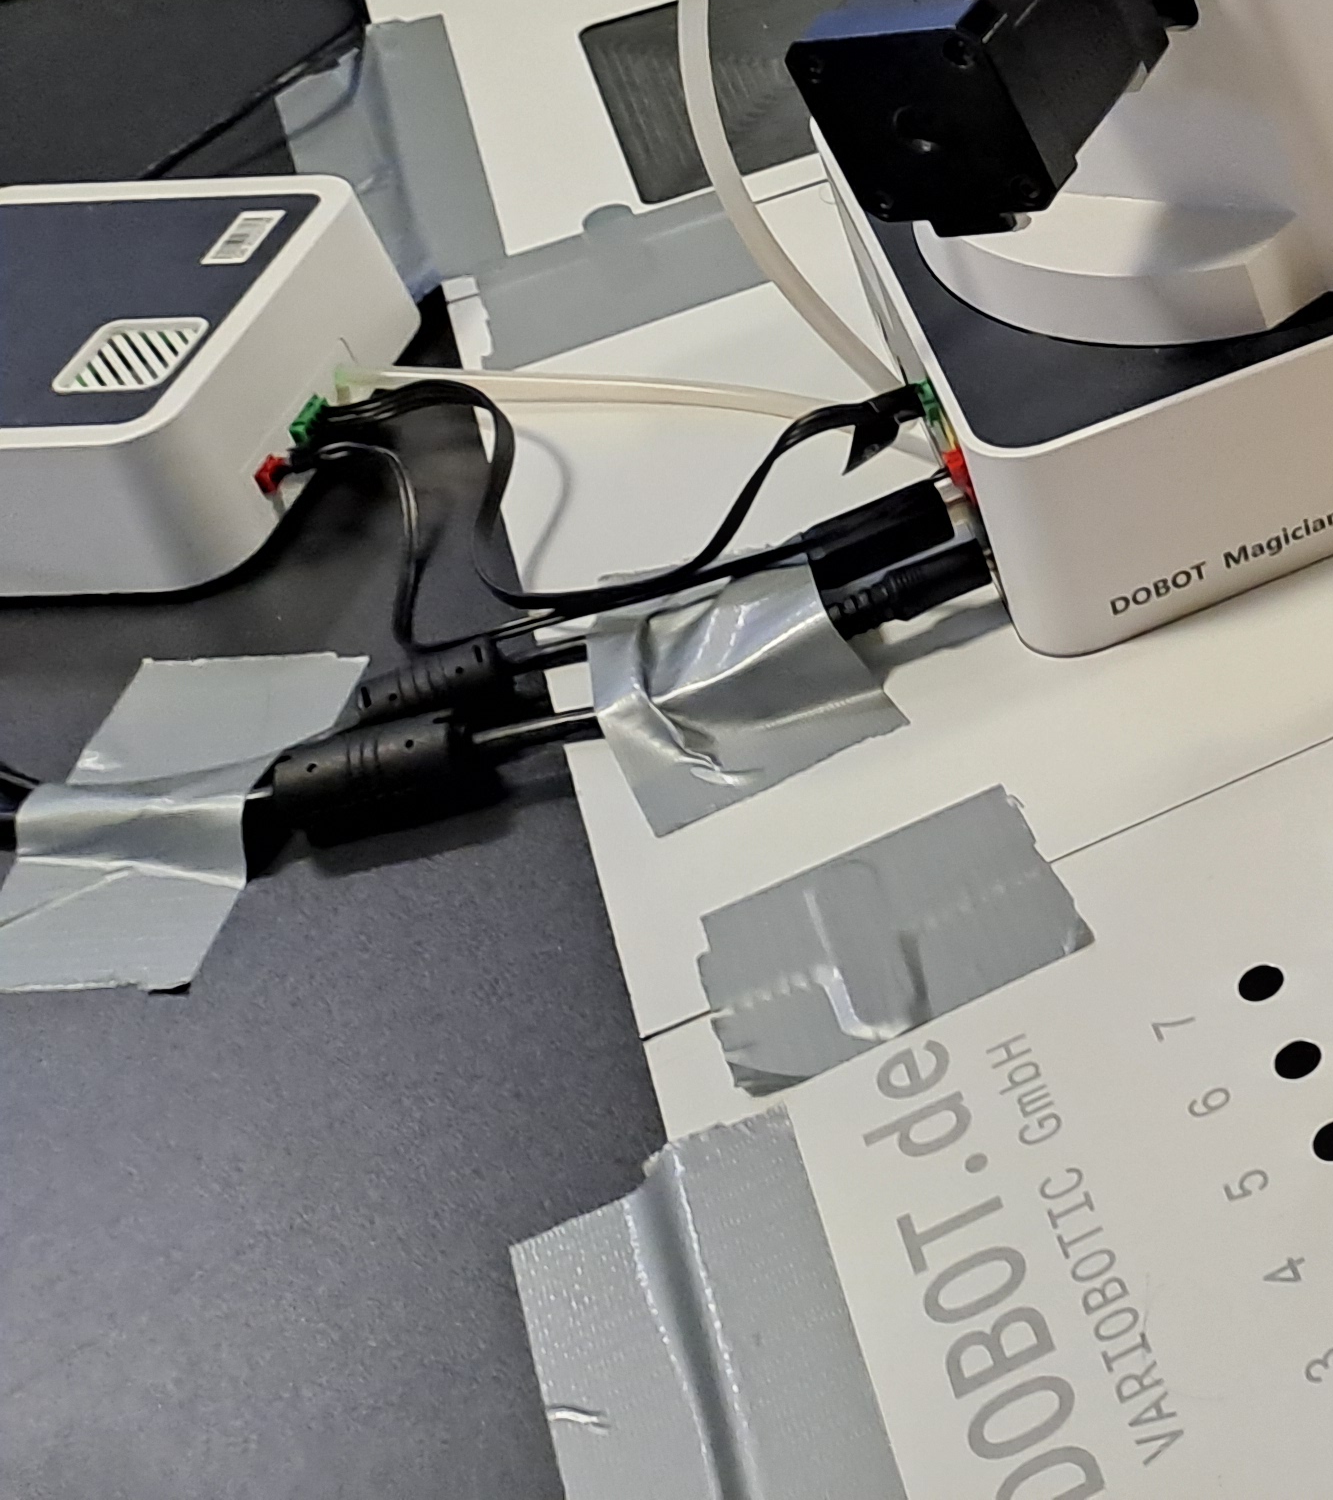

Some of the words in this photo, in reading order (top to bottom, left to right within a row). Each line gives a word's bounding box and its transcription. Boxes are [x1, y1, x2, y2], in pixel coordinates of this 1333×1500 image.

[1108, 560, 1208, 617] DOBOT
[1150, 1015, 1197, 1043] 7
[984, 1032, 1063, 1147] GmbH
[1187, 1087, 1232, 1119] 6
[1223, 1167, 1270, 1203] 5
[861, 1037, 1107, 1500] DOBOT.de
[1262, 1255, 1306, 1284] 4
[1037, 1165, 1186, 1468] VARIOBOTIC
